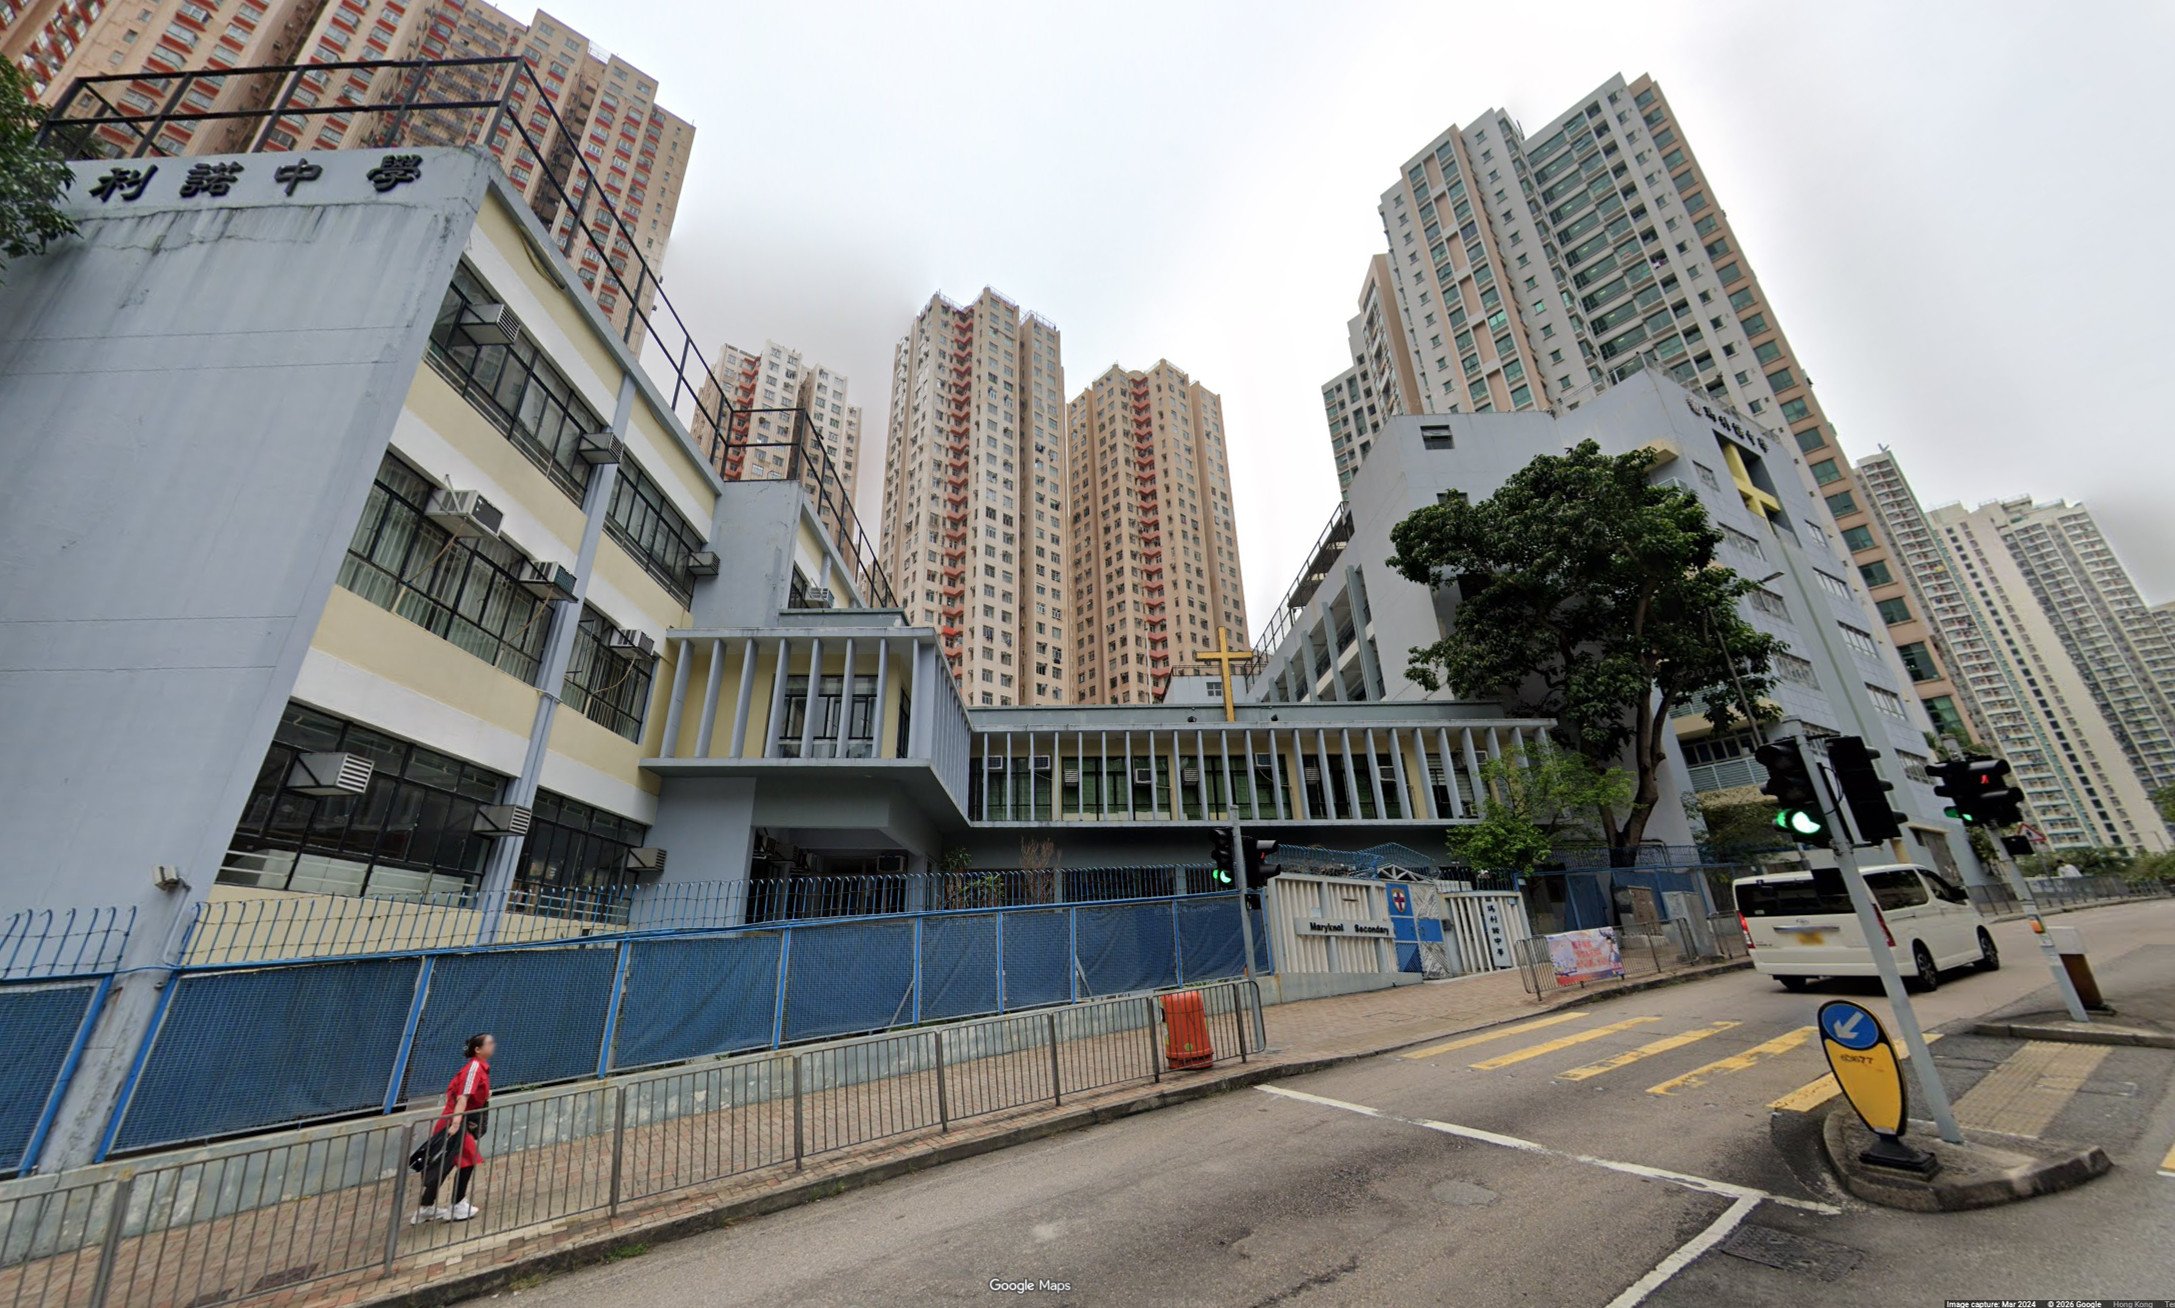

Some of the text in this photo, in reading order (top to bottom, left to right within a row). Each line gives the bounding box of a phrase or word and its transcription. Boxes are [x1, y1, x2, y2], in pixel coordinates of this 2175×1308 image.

[89, 153, 424, 203] 利諾中學
[1354, 924, 1389, 936] Secondary
